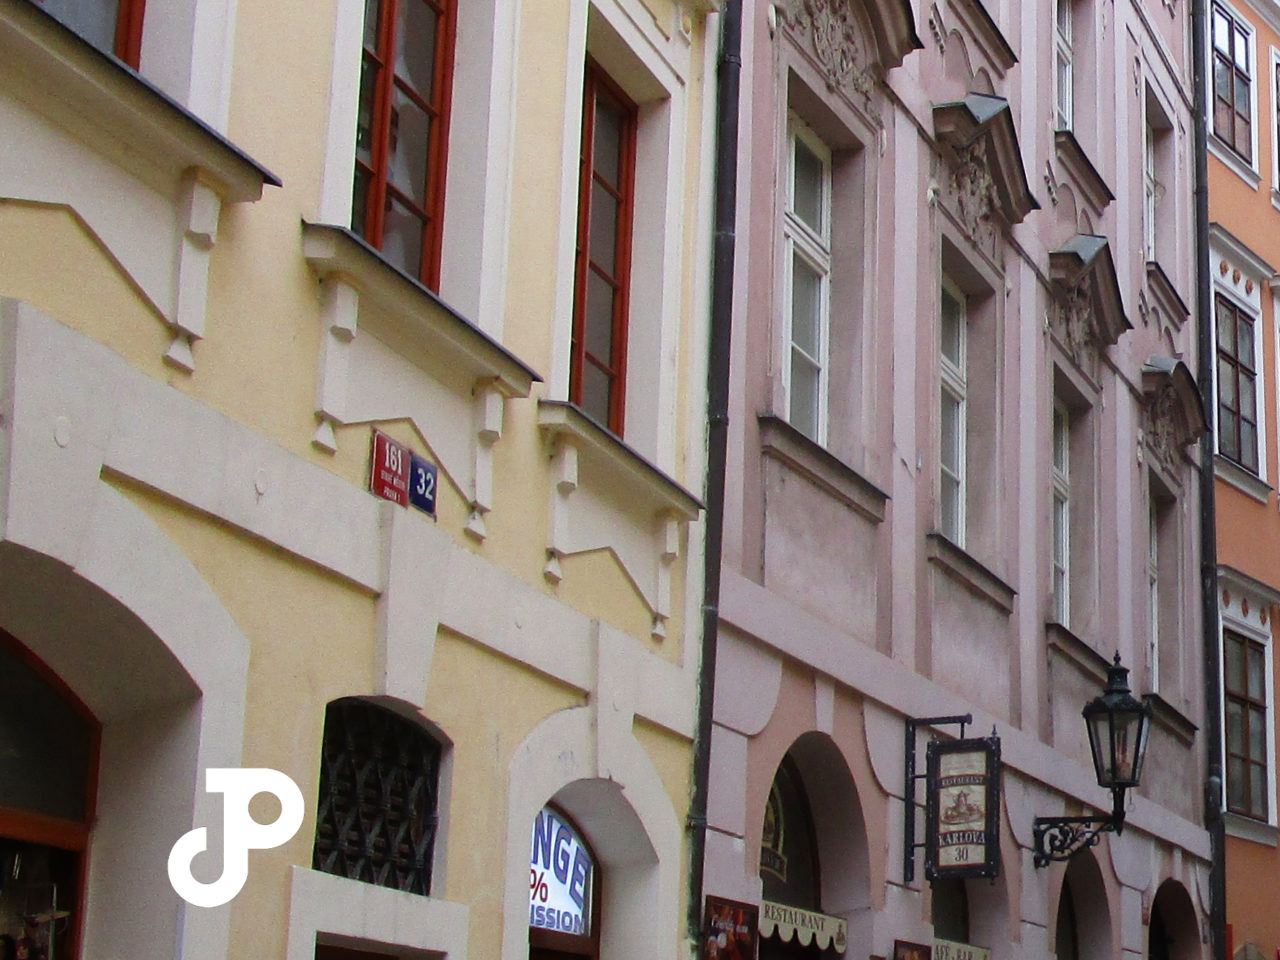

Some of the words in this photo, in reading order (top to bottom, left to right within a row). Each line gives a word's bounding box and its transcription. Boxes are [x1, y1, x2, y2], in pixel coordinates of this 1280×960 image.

[385, 442, 402, 475] 161
[417, 467, 434, 500] 32
[939, 832, 985, 846] KARLOVA
[955, 847, 968, 861] 30
[764, 904, 826, 931] RESTAURANT
